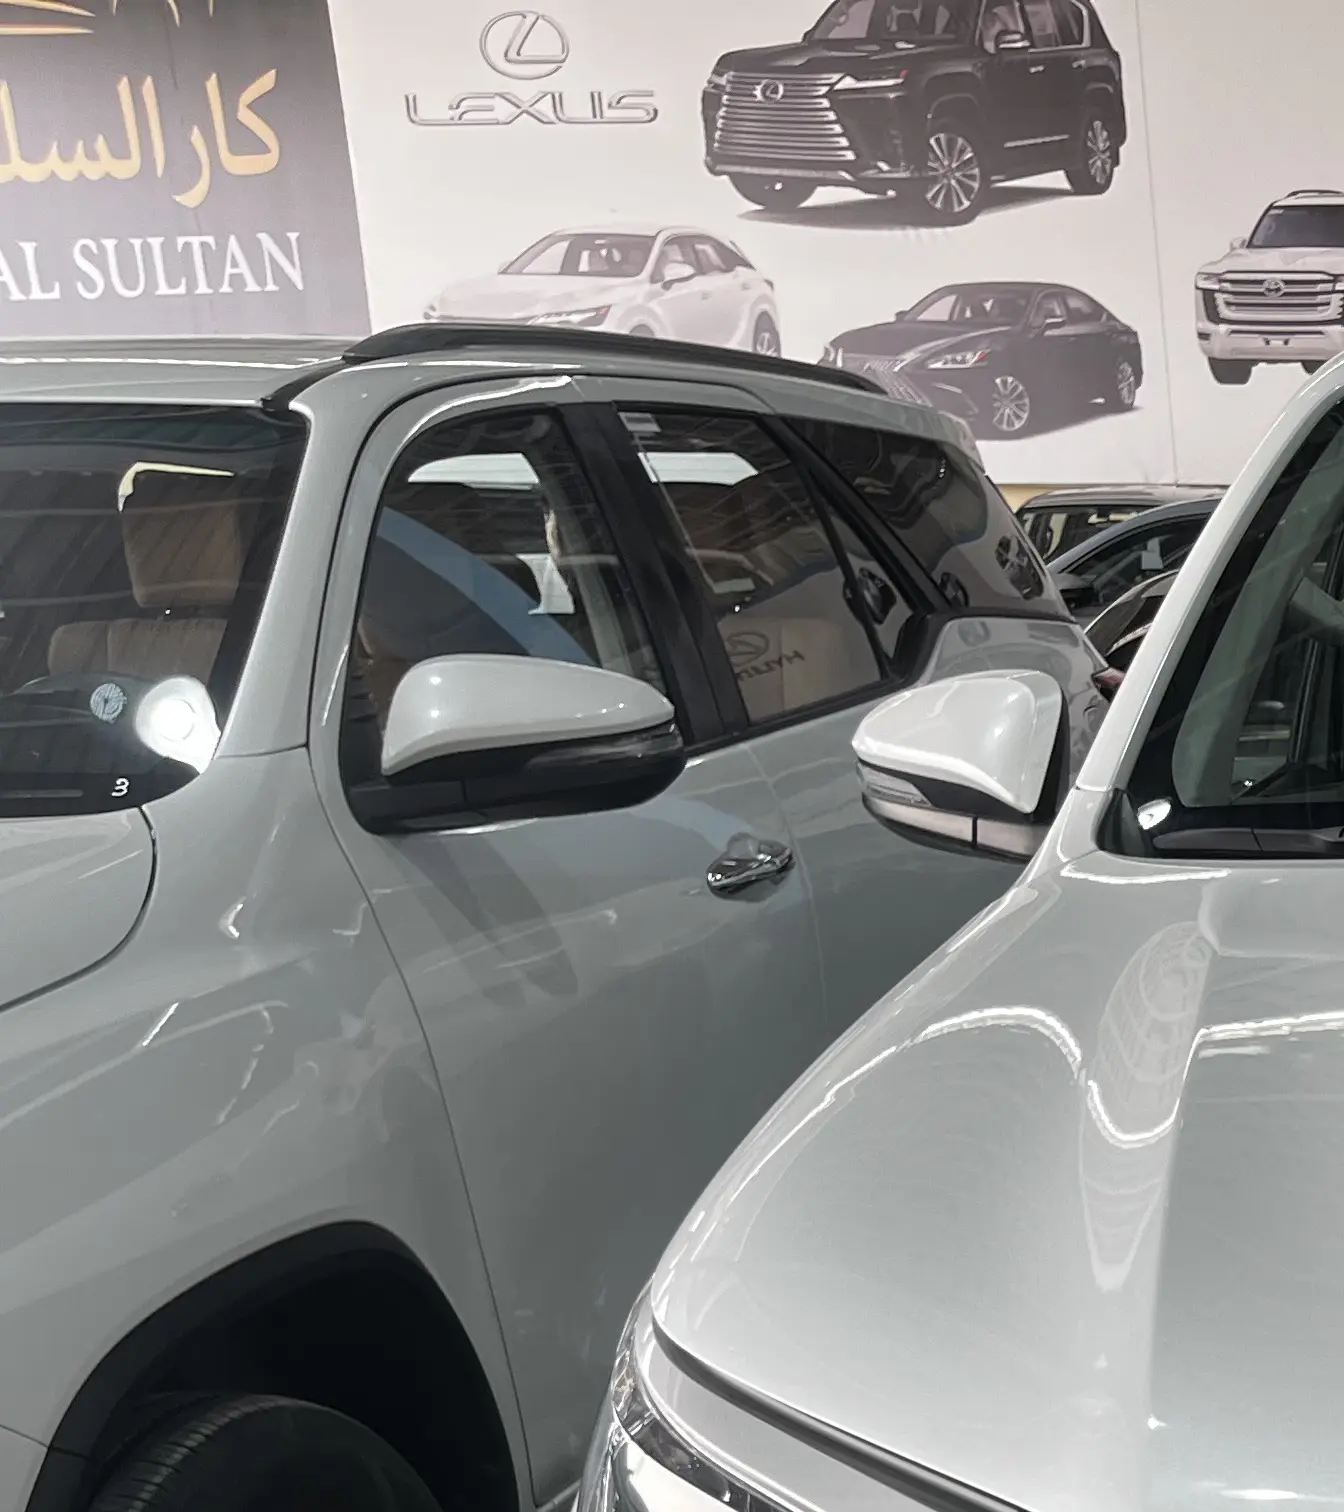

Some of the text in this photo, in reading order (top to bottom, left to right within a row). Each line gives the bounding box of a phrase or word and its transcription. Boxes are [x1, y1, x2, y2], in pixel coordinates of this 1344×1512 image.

[404, 90, 659, 126] LEXUS
[172, 67, 281, 208] كار
[72, 231, 304, 299] SULTAN
[111, 778, 129, 797] 3
